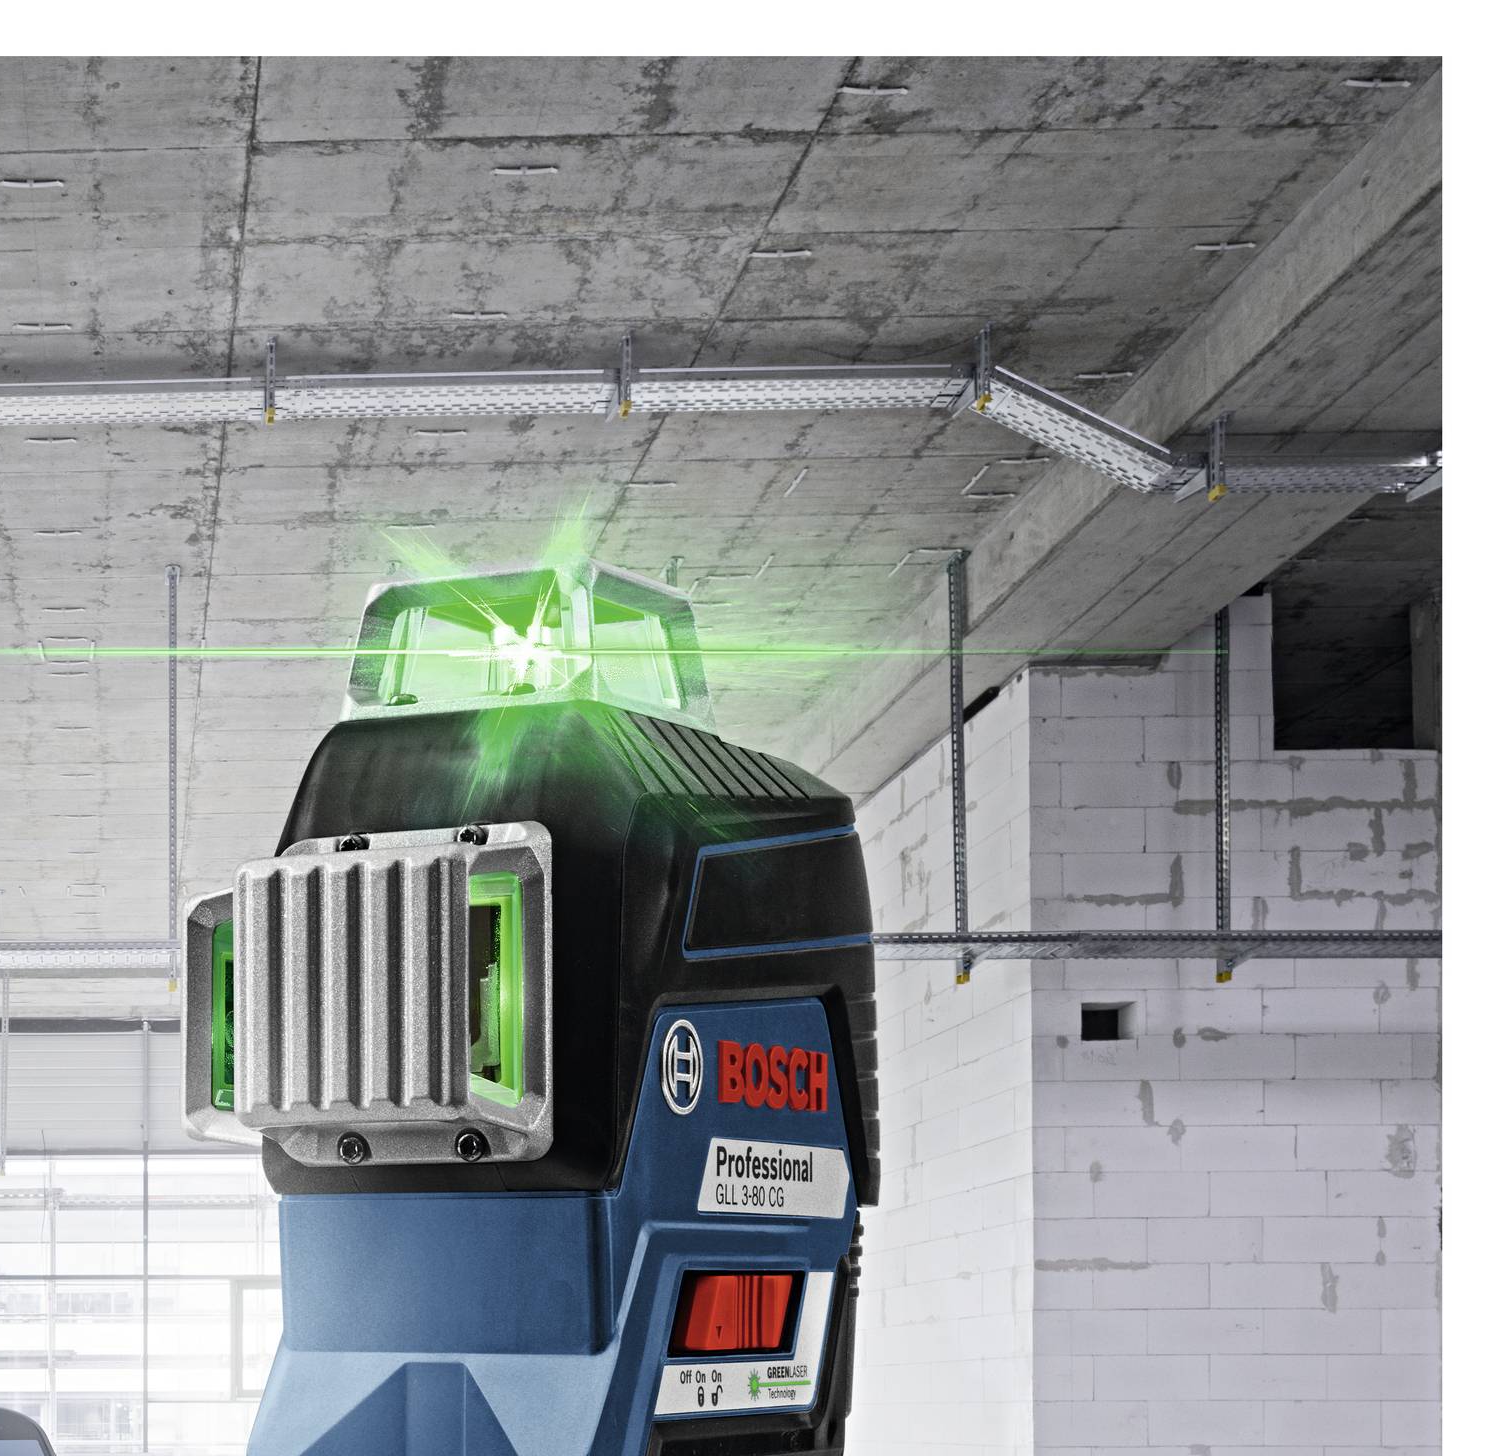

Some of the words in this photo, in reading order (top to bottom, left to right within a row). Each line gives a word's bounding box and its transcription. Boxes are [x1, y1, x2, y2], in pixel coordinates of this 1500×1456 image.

[718, 1040, 828, 1113] BOSCH
[716, 1146, 813, 1182] Professional
[715, 1183, 738, 1206] GLL
[741, 1185, 766, 1207] 3-80
[768, 1186, 785, 1208] CG
[680, 1370, 692, 1385] Off
[695, 1370, 706, 1384] On
[711, 1369, 722, 1383] On
[768, 1388, 797, 1400] Technology
